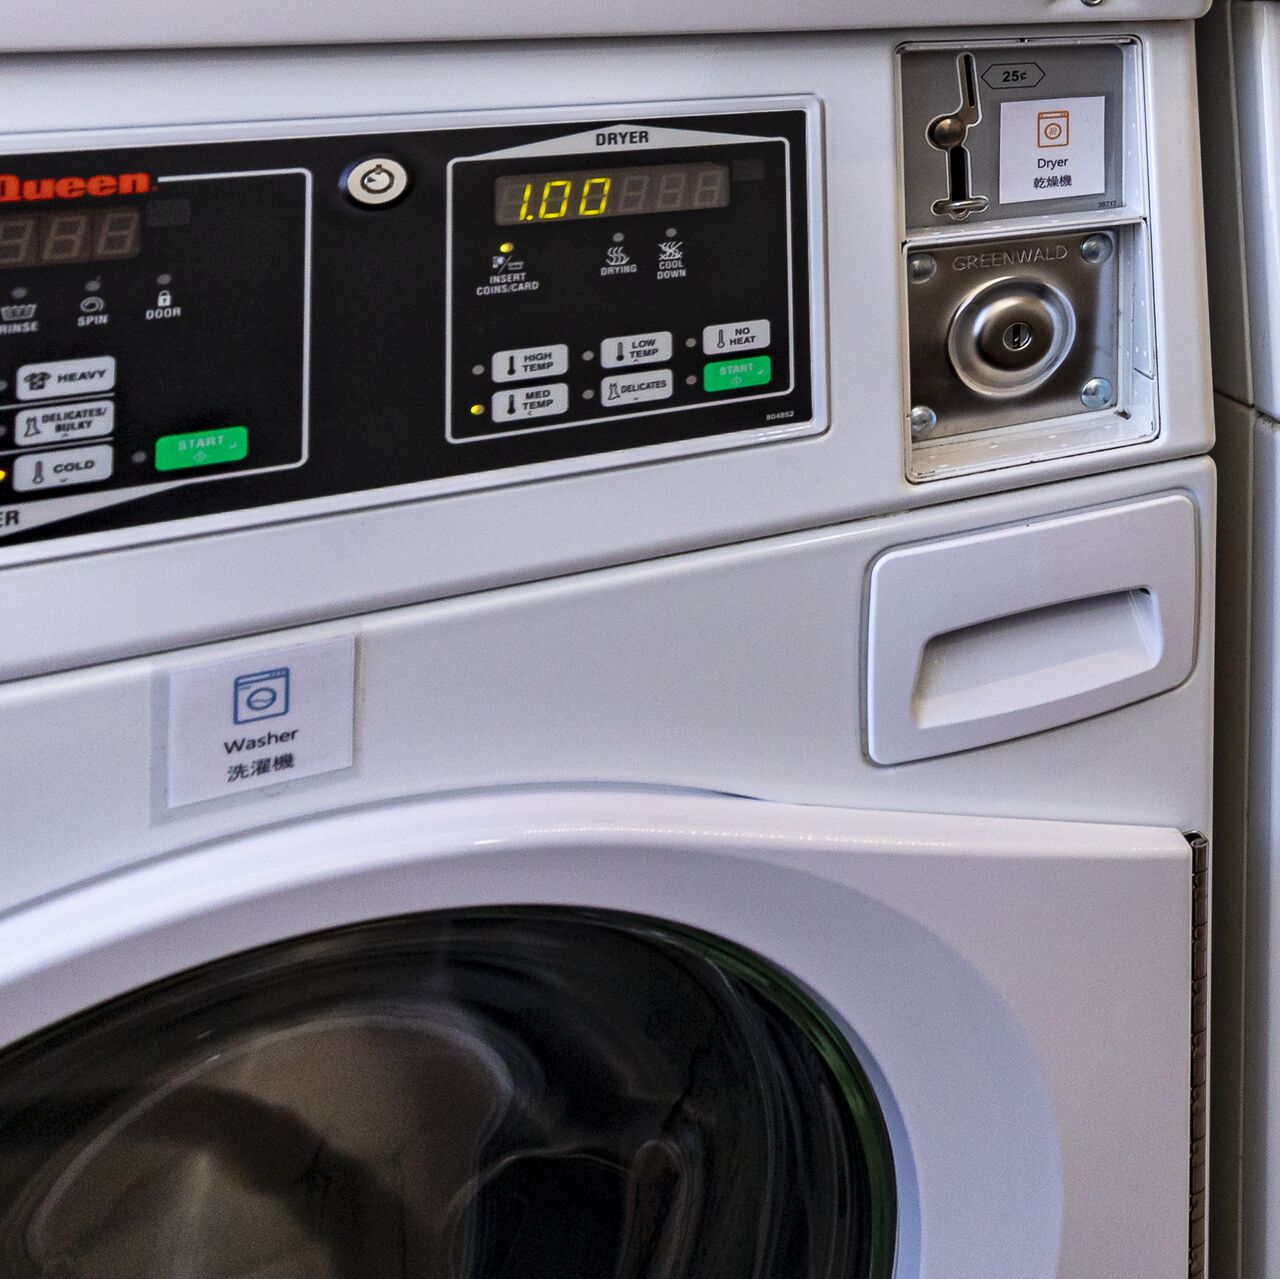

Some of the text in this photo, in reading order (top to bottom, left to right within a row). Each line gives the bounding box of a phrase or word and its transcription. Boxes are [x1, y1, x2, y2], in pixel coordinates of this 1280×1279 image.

[1002, 70, 1027, 82] 25¢
[596, 131, 648, 146] DRYER
[1038, 158, 1068, 170] Dryer
[1033, 174, 1072, 189] 乾燥機
[519, 177, 611, 220] 1.00
[952, 245, 1068, 271] GREENWALD
[600, 264, 637, 276] DRYING
[659, 261, 683, 270] COOL
[490, 272, 526, 284] INSERT
[657, 269, 686, 280] DOWN
[476, 281, 539, 296] COINS/CARD
[146, 307, 181, 320] DOOR
[78, 314, 108, 327] SPIN
[735, 327, 750, 336] NO
[632, 339, 656, 348] LOW
[729, 335, 756, 346] HEAT
[524, 352, 552, 363] HIGH
[630, 348, 659, 359] TEMP
[522, 361, 554, 373] TEMP
[719, 363, 753, 376] START
[58, 369, 106, 384] HEAVY
[621, 379, 667, 393] DELICATES
[525, 390, 550, 400] MED
[522, 399, 554, 410] TEMP
[42, 407, 106, 424] DELICATES/
[55, 420, 93, 432] BULKY
[178, 435, 224, 452] START
[53, 460, 94, 473] COLD
[224, 729, 299, 754] Washer
[227, 753, 294, 783] 洗濯機
